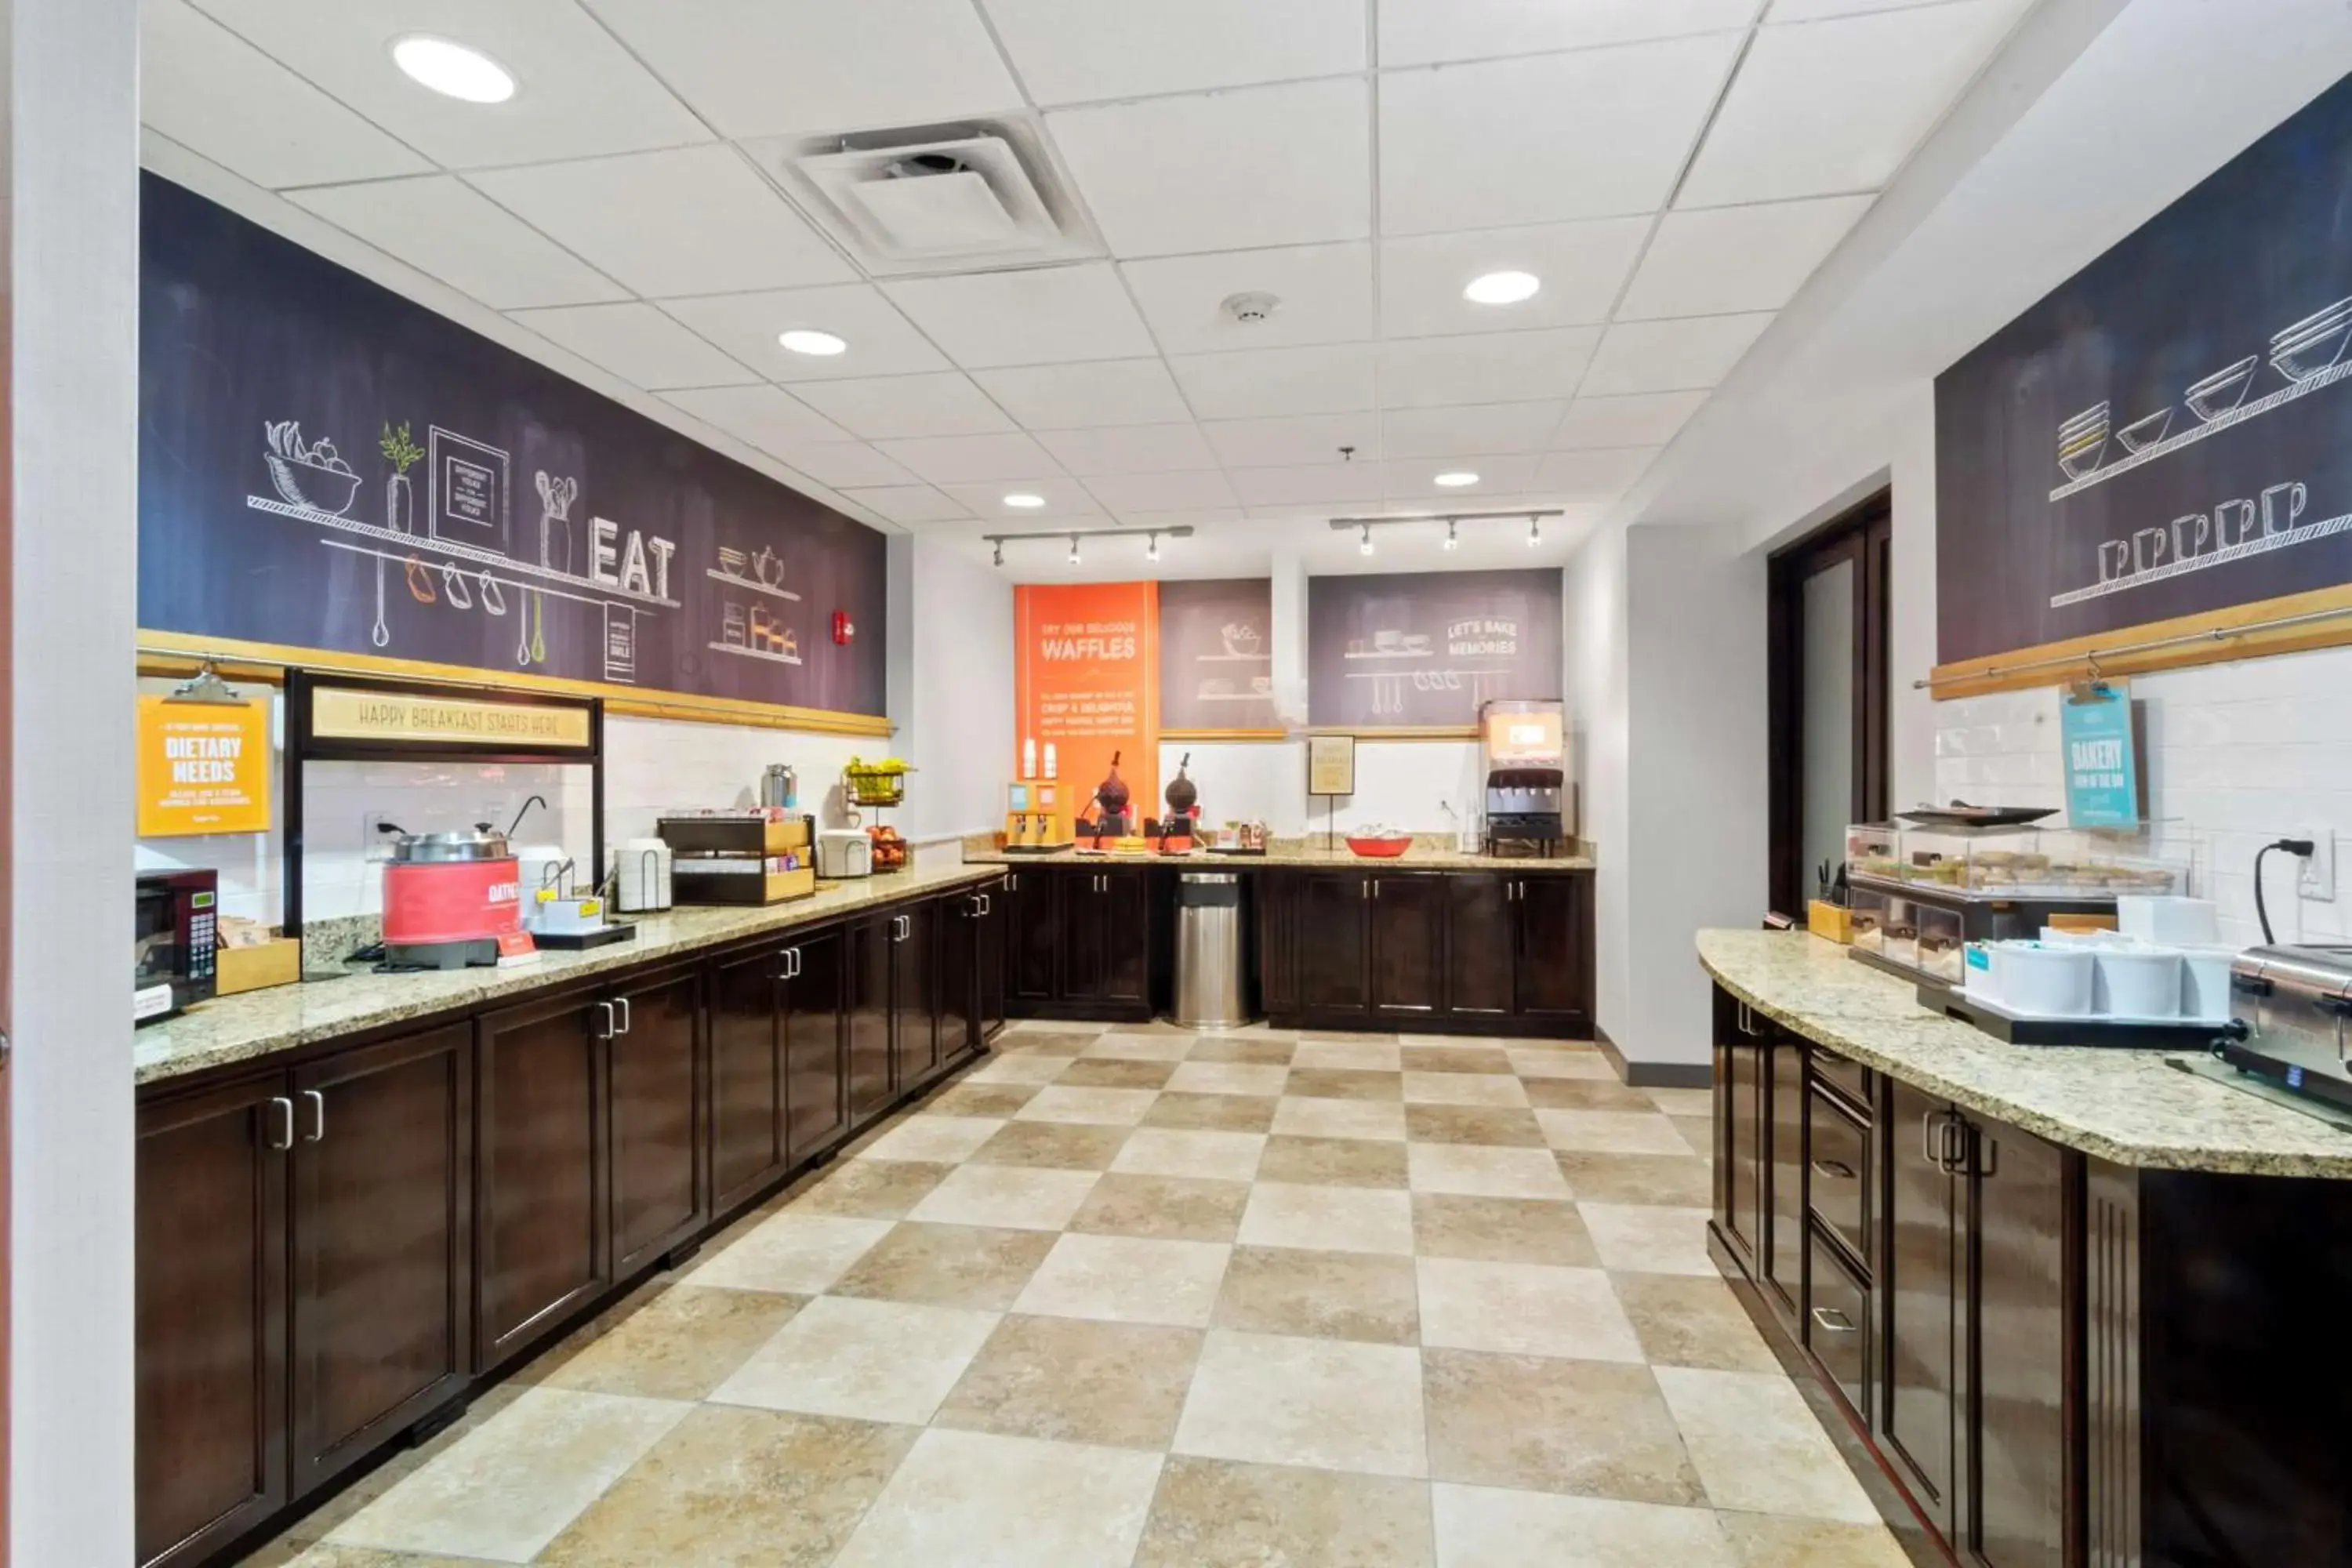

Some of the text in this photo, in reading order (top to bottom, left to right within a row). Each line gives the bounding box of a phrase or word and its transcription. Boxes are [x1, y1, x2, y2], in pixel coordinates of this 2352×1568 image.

[589, 516, 676, 600] EAT
[1447, 620, 1518, 640] LET'S BAKE
[1041, 637, 1135, 661] WAFFLES
[1448, 641, 1517, 655] MEMORIES
[359, 702, 559, 735] HAPPY BREAKFAST STARTS HERE
[165, 737, 242, 759] DIETARY
[2071, 739, 2122, 771] BAKERY
[173, 760, 235, 783] NEEDS
